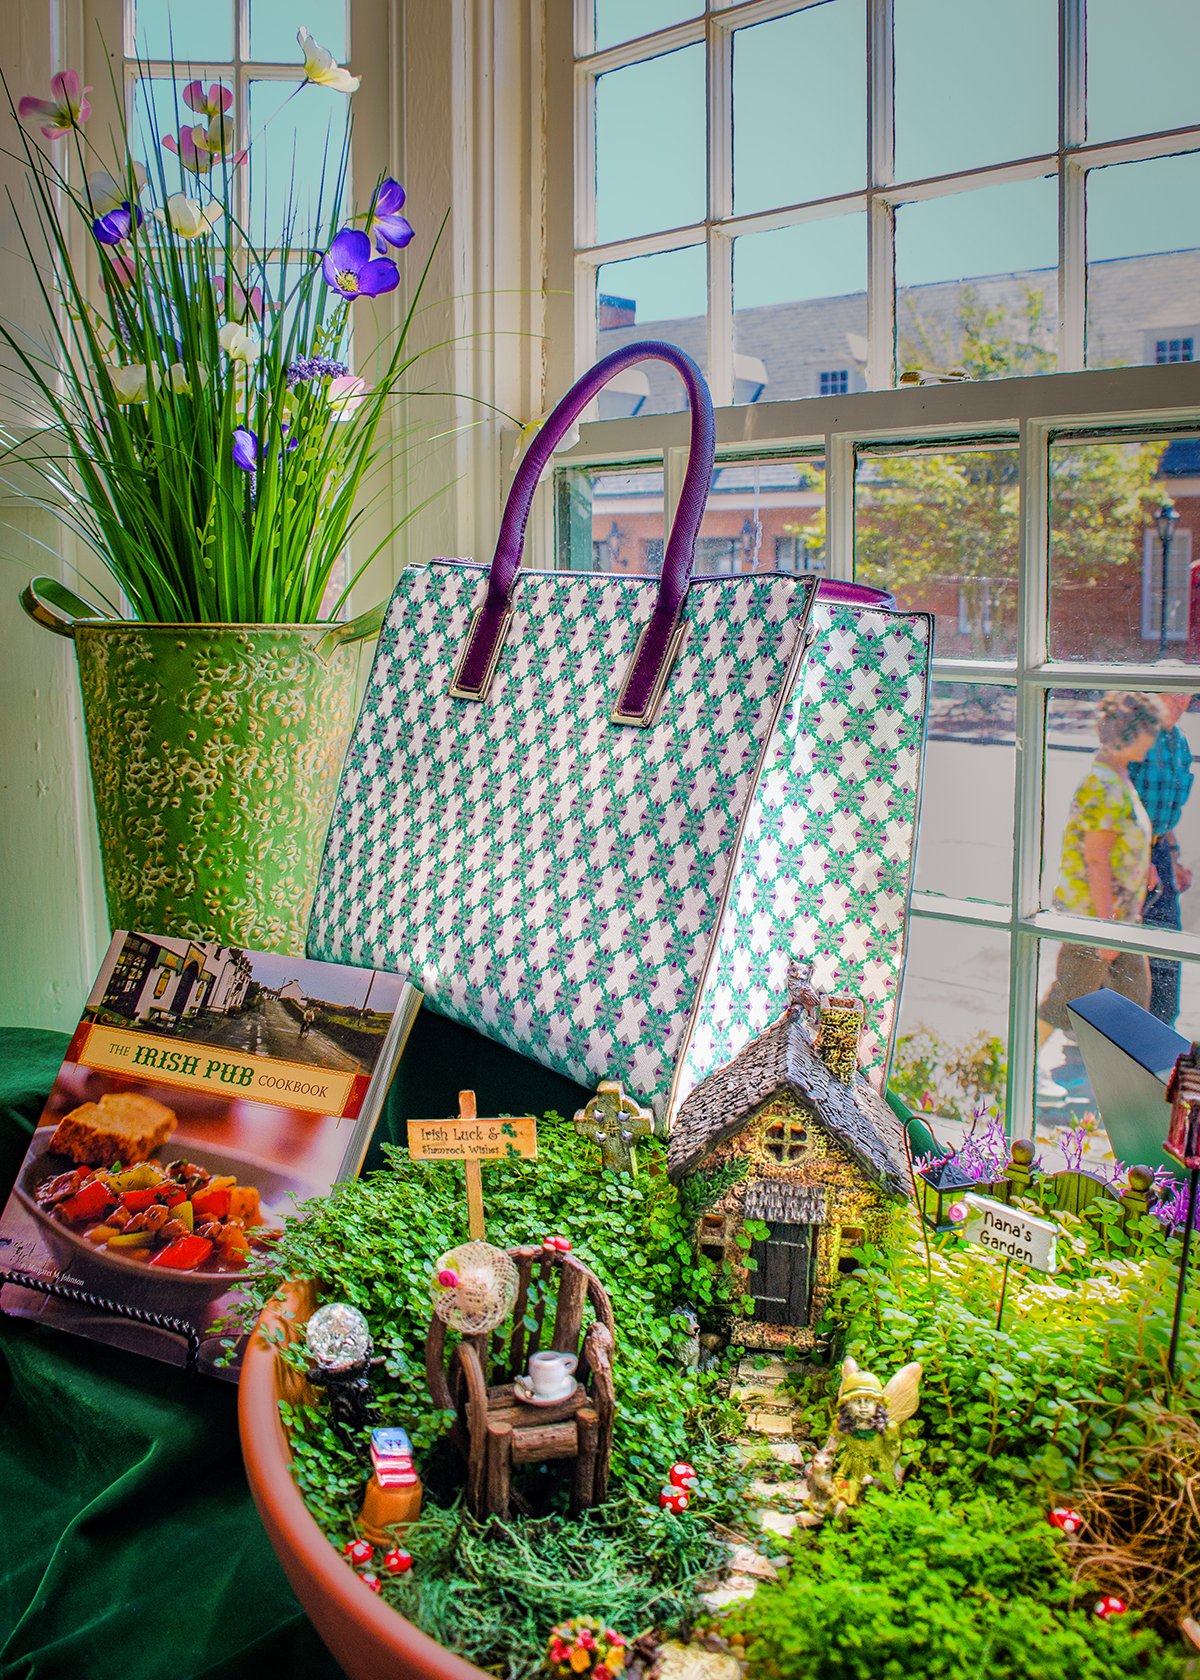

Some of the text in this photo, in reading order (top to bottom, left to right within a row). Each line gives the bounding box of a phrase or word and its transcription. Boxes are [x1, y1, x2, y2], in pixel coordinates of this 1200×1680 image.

[109, 1043, 329, 1099] THE IRISH PUB COOKBOOK
[421, 1126, 500, 1142] Irish Luck &
[422, 1144, 500, 1155] Shamrock Wishes
[984, 1210, 1032, 1243] Nana's
[980, 1229, 1033, 1264] Garden
[28, 1263, 53, 1277] Margaret
[60, 1272, 85, 1287] Johnson
